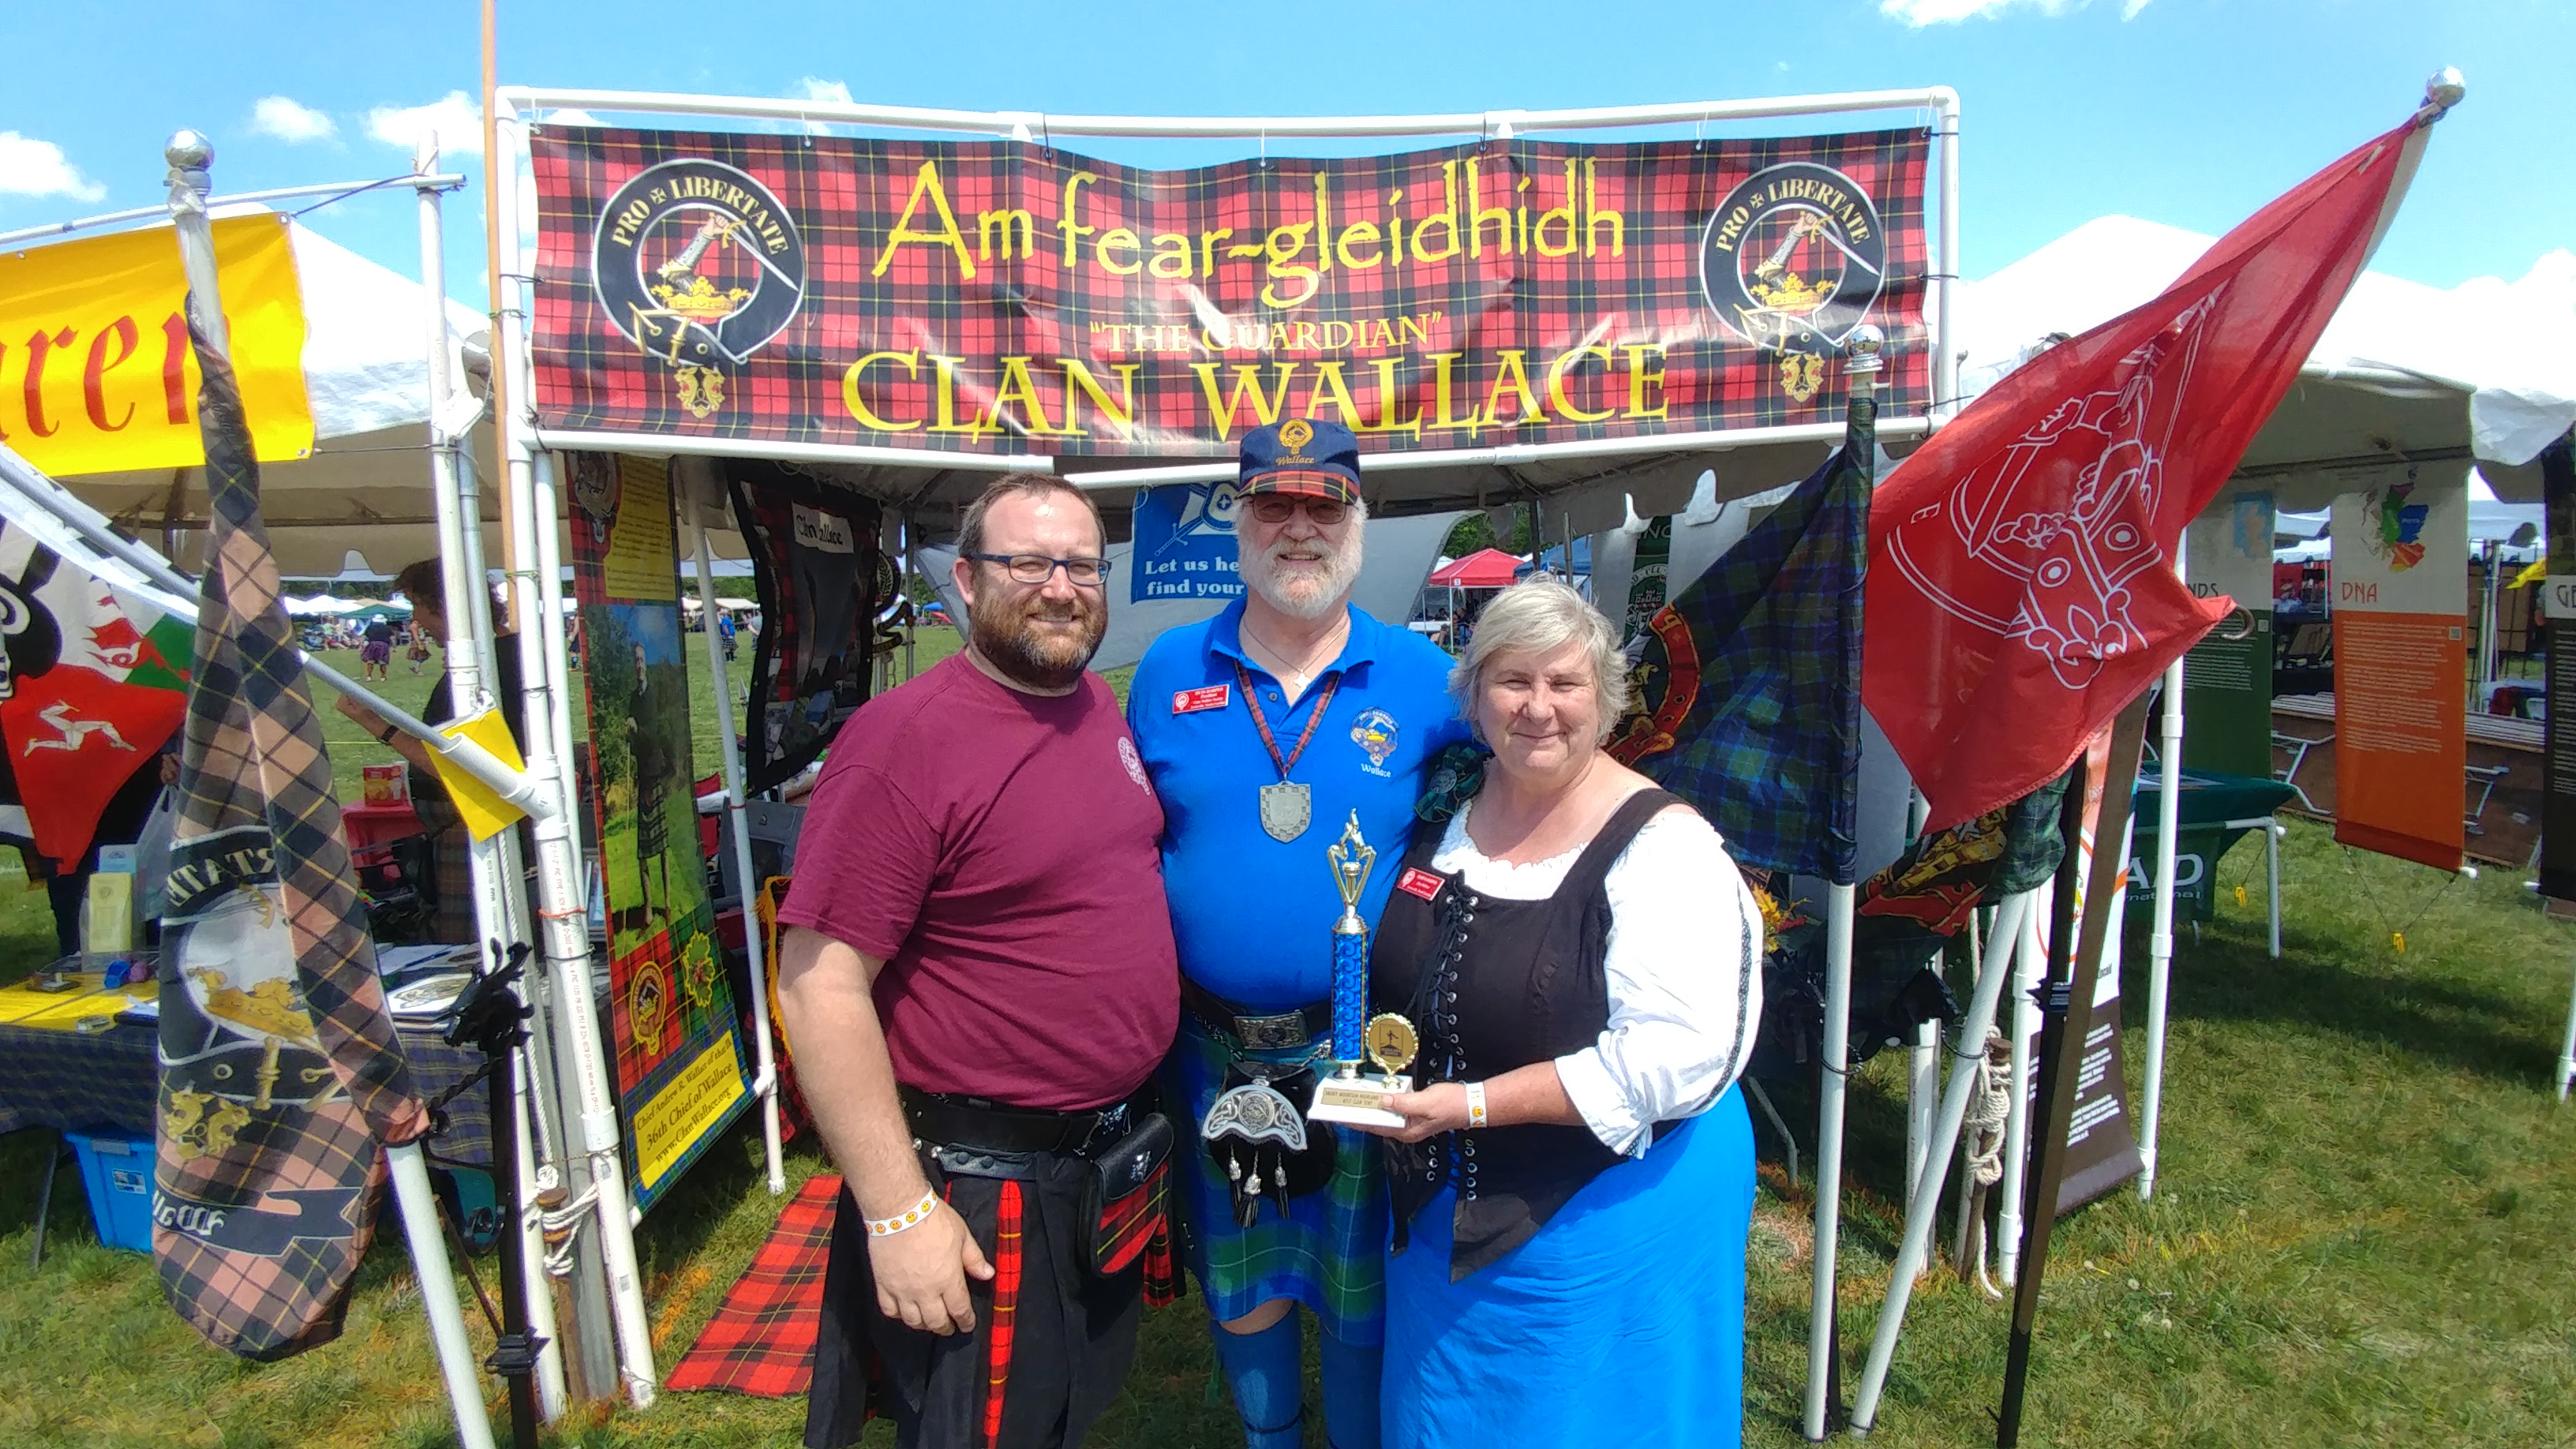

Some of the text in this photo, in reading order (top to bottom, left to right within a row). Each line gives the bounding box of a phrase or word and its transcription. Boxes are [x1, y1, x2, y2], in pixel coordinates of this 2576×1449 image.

[612, 175, 789, 256] PRO LIBERTATE
[871, 155, 1624, 309] Am fear-gleidhidh
[1716, 178, 1870, 253] PRO LIBERTATE
[842, 339, 1669, 445] CLAN WALLACE
[1275, 455, 1315, 466] Wallace
[1144, 558, 1178, 575] Let
[1184, 560, 1209, 571] us
[1147, 578, 1245, 597] find your
[2341, 581, 2378, 605] DNA
[1360, 762, 1392, 778] Wallace
[637, 1108, 655, 1131] Chief
[656, 1088, 679, 1112] Andrew
[686, 1061, 708, 1084] Wallace
[646, 1062, 733, 1152] 36th Chief of Wallace
[655, 1086, 732, 1163] www.ClanWallace.org
